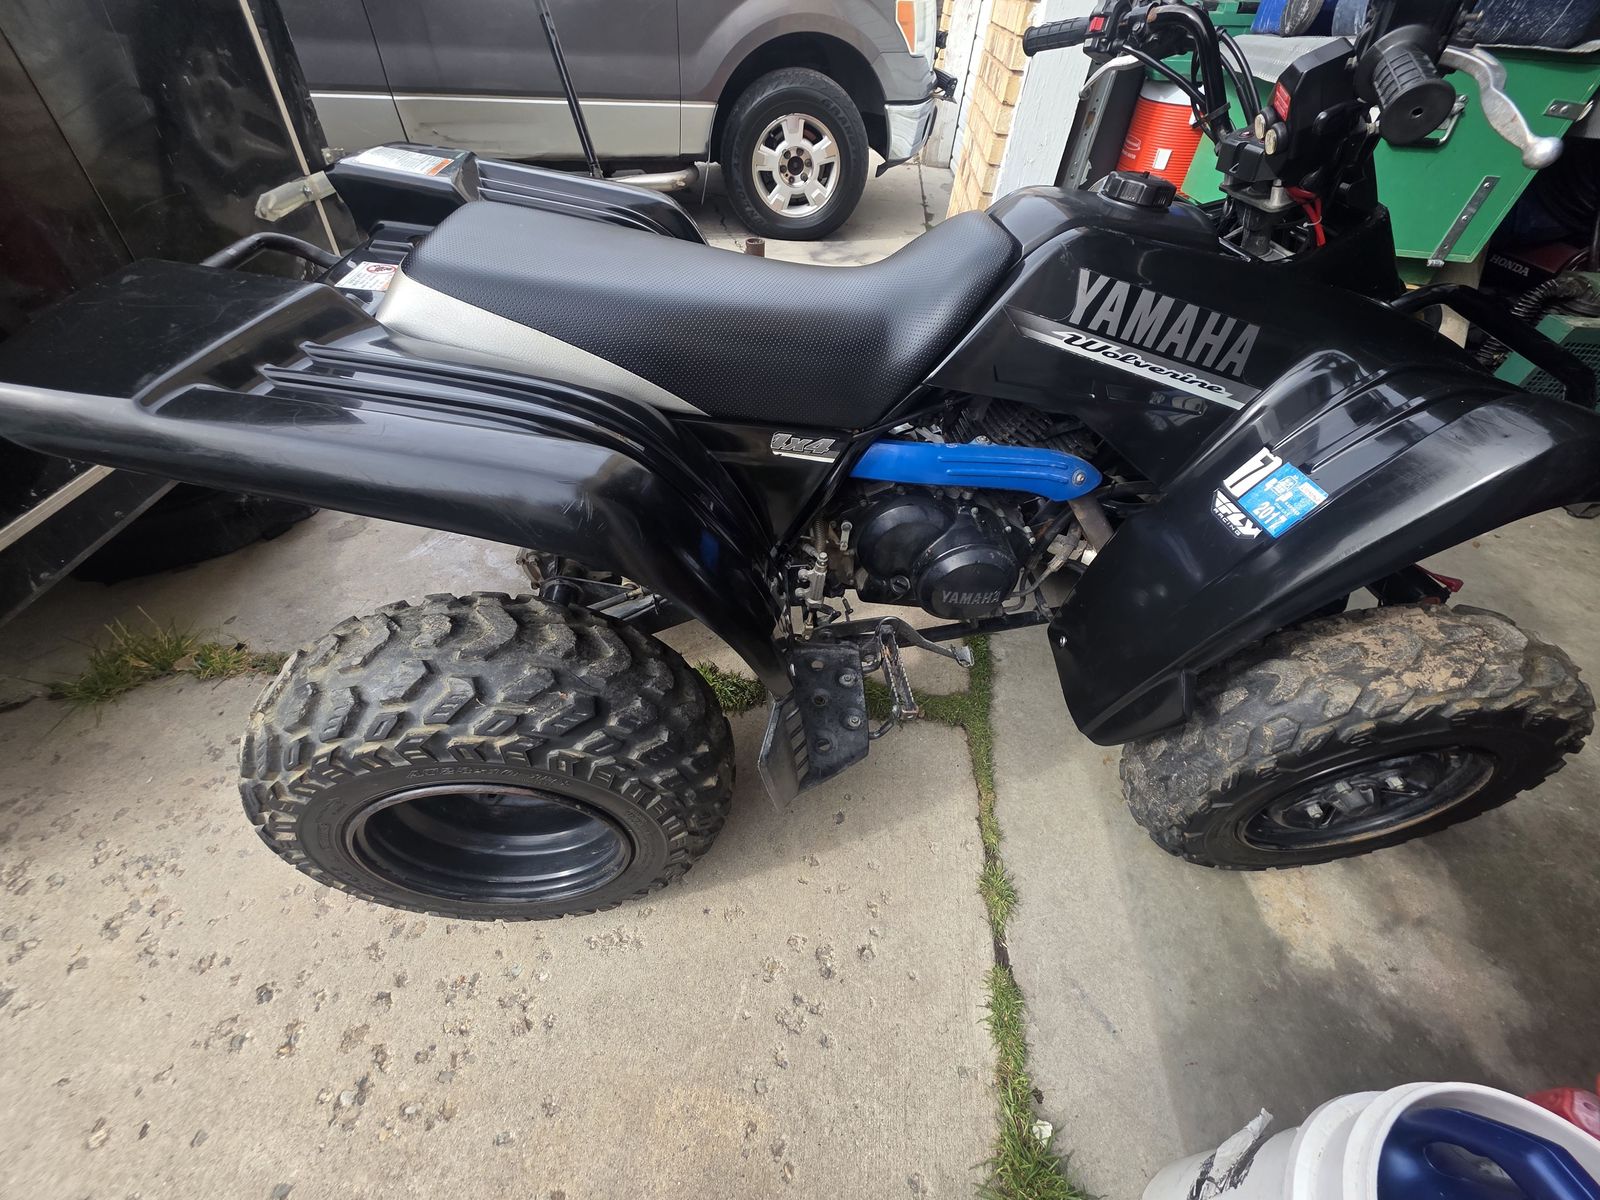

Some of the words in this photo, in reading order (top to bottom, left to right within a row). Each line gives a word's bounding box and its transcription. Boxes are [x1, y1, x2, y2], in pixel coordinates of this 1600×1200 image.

[1489, 254, 1530, 277] HONDA
[1069, 268, 1261, 377] YAMAHA
[1064, 333, 1224, 394] Wolverine
[1212, 507, 1242, 537] RACING
[1215, 491, 1262, 538] FLY
[1252, 502, 1288, 531] 2017
[942, 590, 1001, 605] YAMAHA
